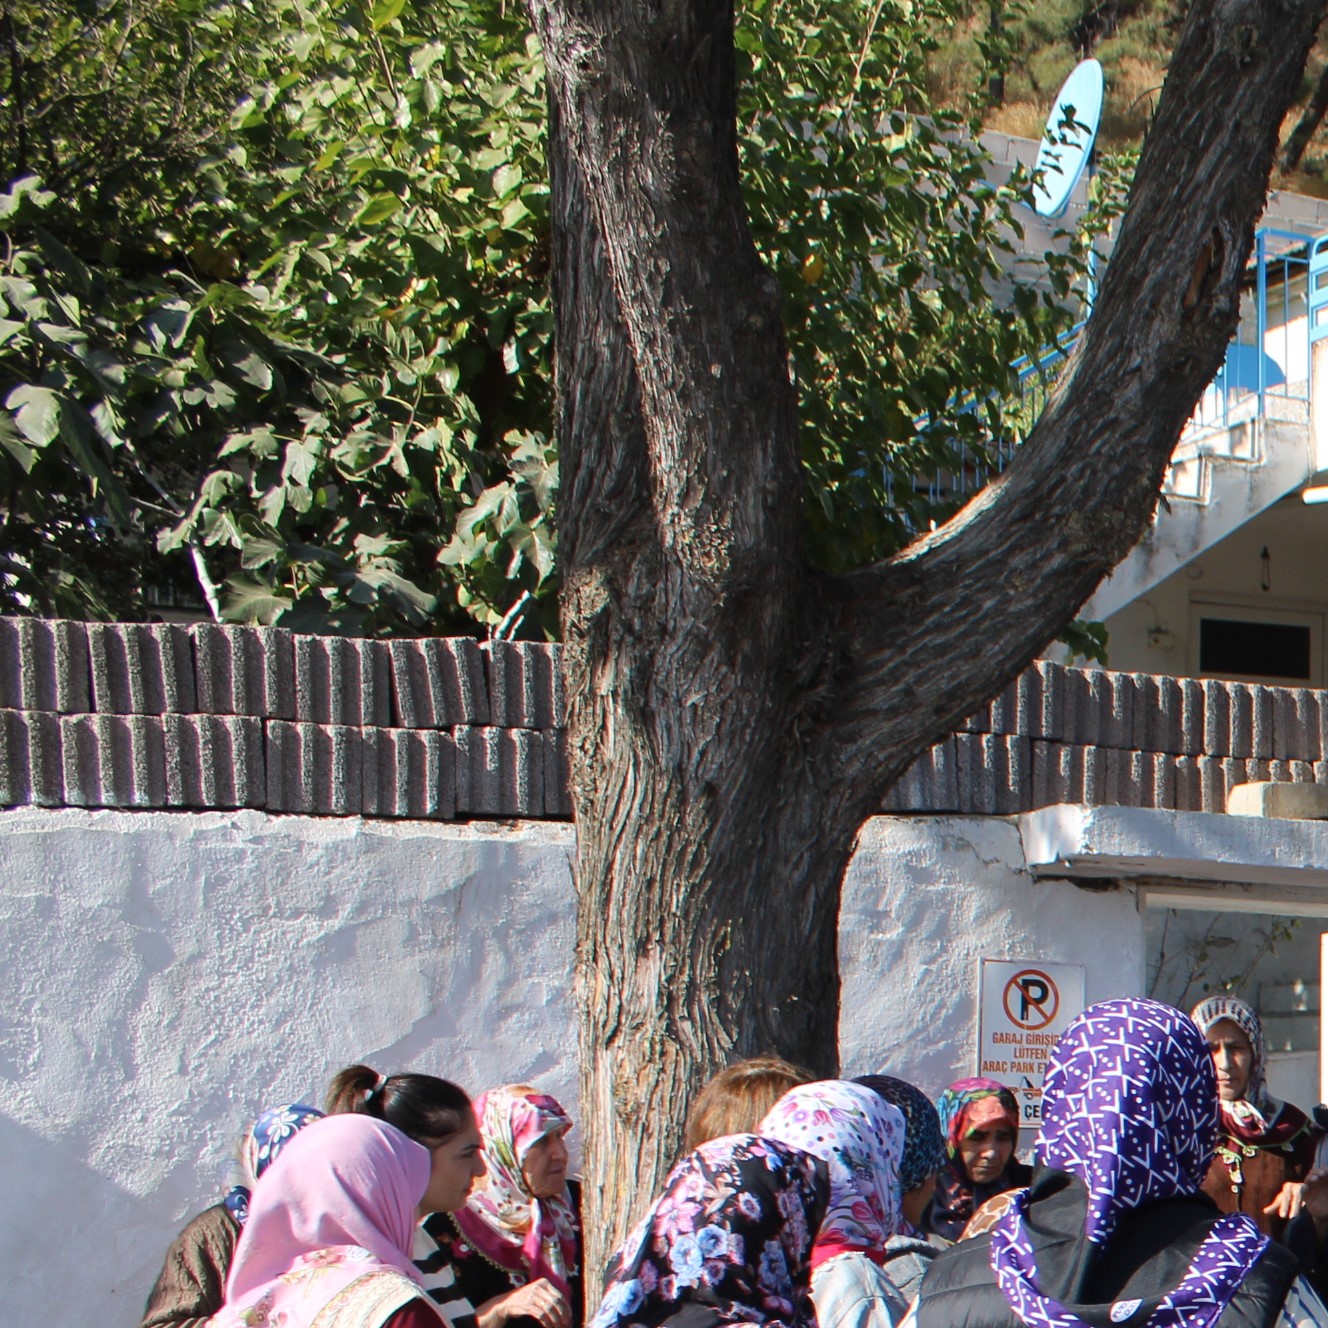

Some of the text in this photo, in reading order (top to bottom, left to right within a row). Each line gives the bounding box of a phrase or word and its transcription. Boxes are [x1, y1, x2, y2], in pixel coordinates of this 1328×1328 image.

[992, 1032, 1023, 1045] GARAJ
[1014, 1045, 1048, 1060] LÜTFEN
[983, 1060, 1008, 1075] ARAÇ
[1010, 1061, 1034, 1073] PARK
